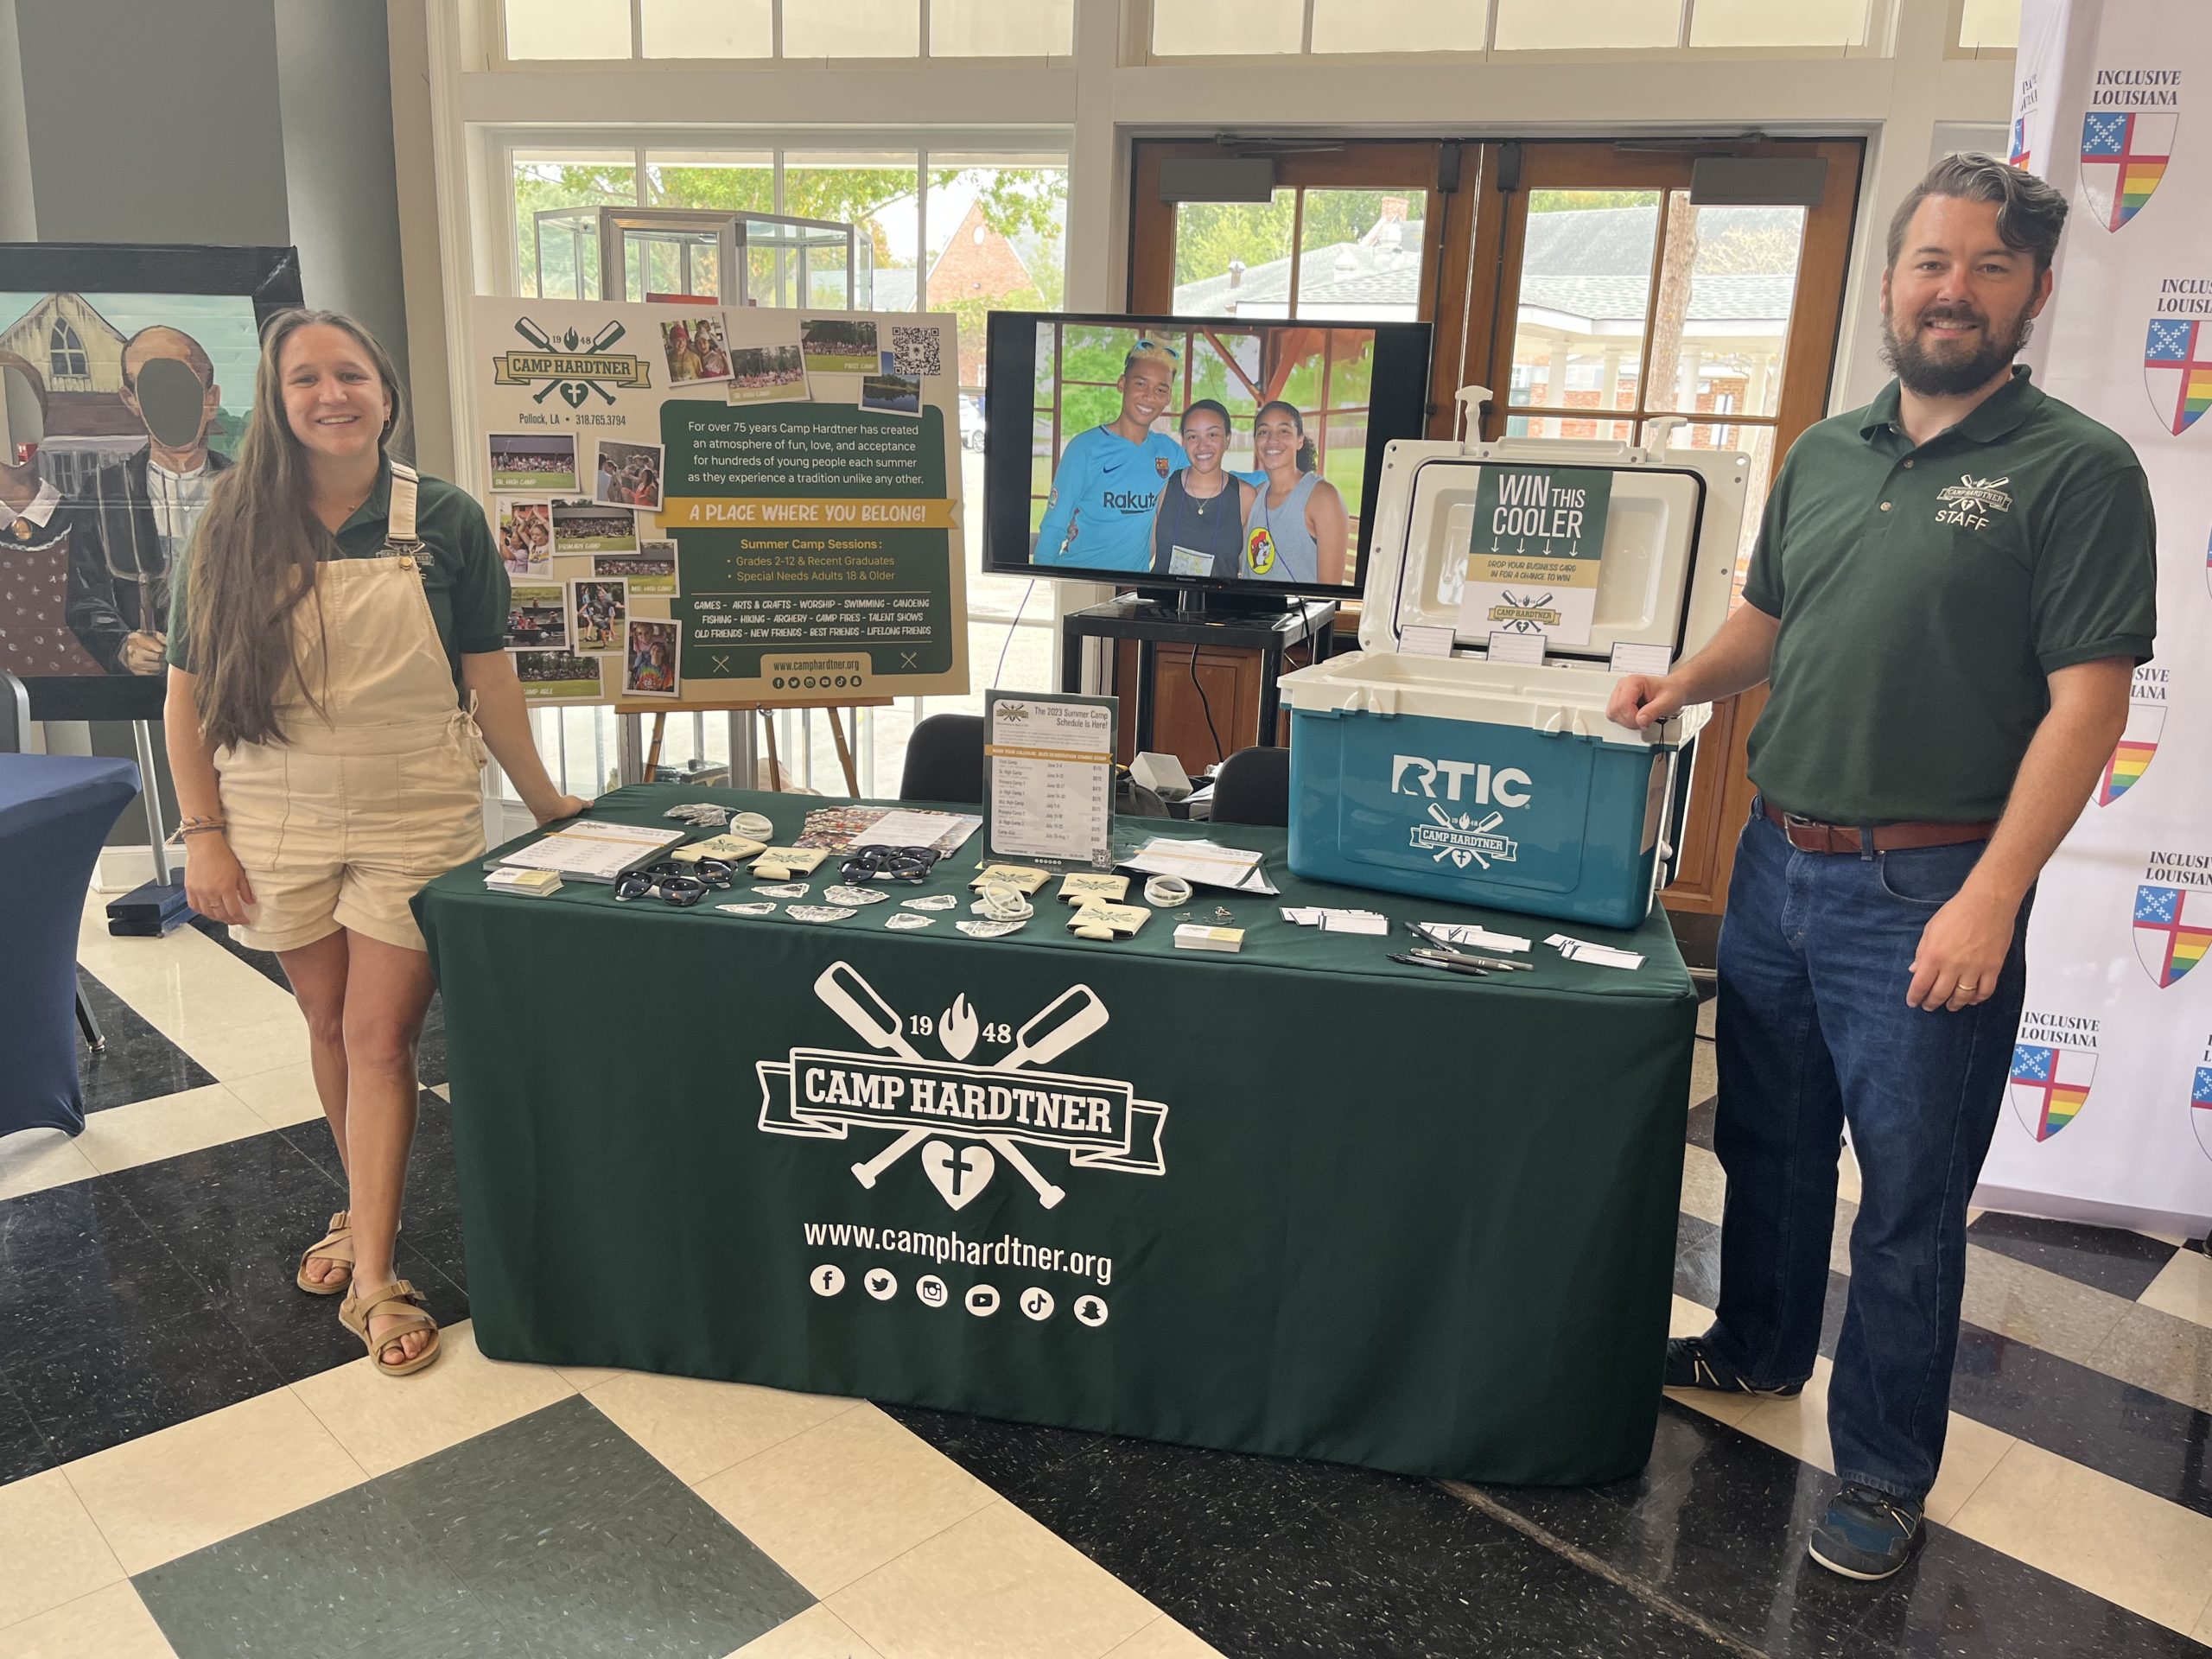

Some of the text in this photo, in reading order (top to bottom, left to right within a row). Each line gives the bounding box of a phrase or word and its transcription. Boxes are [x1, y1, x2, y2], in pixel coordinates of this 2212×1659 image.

[2096, 70, 2181, 86] INCLUSIVE
[2092, 90, 2178, 105] LOUISIANA
[552, 335, 591, 345] 19 48
[512, 358, 631, 375] CAMP HARDTNER
[518, 413, 560, 426] Pollock, LA
[575, 414, 626, 426] 318.765.3794
[688, 421, 919, 435] For over 75 years Camp Hardtner has created
[693, 439, 917, 454] an atmosphere of fun, love, and acceptance
[693, 454, 918, 469] for hundreds of young people each summer
[688, 472, 925, 486] as they experience a tradition unlike any other.
[1498, 474, 1586, 509] WIN THIS
[1965, 489, 2004, 503] HARDTNER
[689, 503, 926, 523] A PLACE WHERE YOU BELONG!
[1935, 509, 1990, 531] STAFF
[1492, 506, 1584, 539] COOLER
[557, 542, 584, 550] PRIMARY
[741, 538, 790, 550] Summer
[791, 538, 825, 551] Camp
[735, 556, 895, 566] Grades 2-12 & Recent Graduates
[1488, 560, 1507, 569] DROP
[1508, 561, 1526, 569] YOUR
[1526, 562, 1558, 572] BUSINESS
[736, 570, 896, 583] Special Needs Adults 18 & Older
[1499, 570, 1513, 579] FOR
[1520, 571, 1545, 581] CHANCE
[1547, 573, 1555, 582] TO
[1556, 574, 1571, 582] WIN
[694, 598, 930, 610] GAMES ARTS & CRAFTS WORSHIP SWIMMING CANOEING
[702, 612, 924, 625] FISHING HIKING ARCHERY CAMP FIRES TALENT SHOWS
[1497, 608, 1552, 620] CAMP HARDTNER
[694, 626, 931, 639] OLD FRIENDS NEW FRIENDS BEST FRIENDS LIFELONG FRIENDS
[773, 658, 860, 672] www.camphardtner.org
[1034, 706, 1046, 716] The
[1047, 708, 1063, 717] 2023
[1064, 709, 1089, 719] Summer
[1090, 710, 1109, 720] Camp
[1056, 717, 1109, 729] Schedule Is Here!
[1391, 754, 1533, 809] RTIC
[1422, 829, 1503, 851] CAMP HARDTNER
[910, 1014, 1012, 1044] 19 48
[2024, 1011, 2101, 1033] INCLUSIVE
[2020, 1027, 2098, 1048] LOUISIANA
[804, 1066, 1112, 1135] CAMP HARDTNER
[804, 1223, 1112, 1287] www.camphardtner.org
